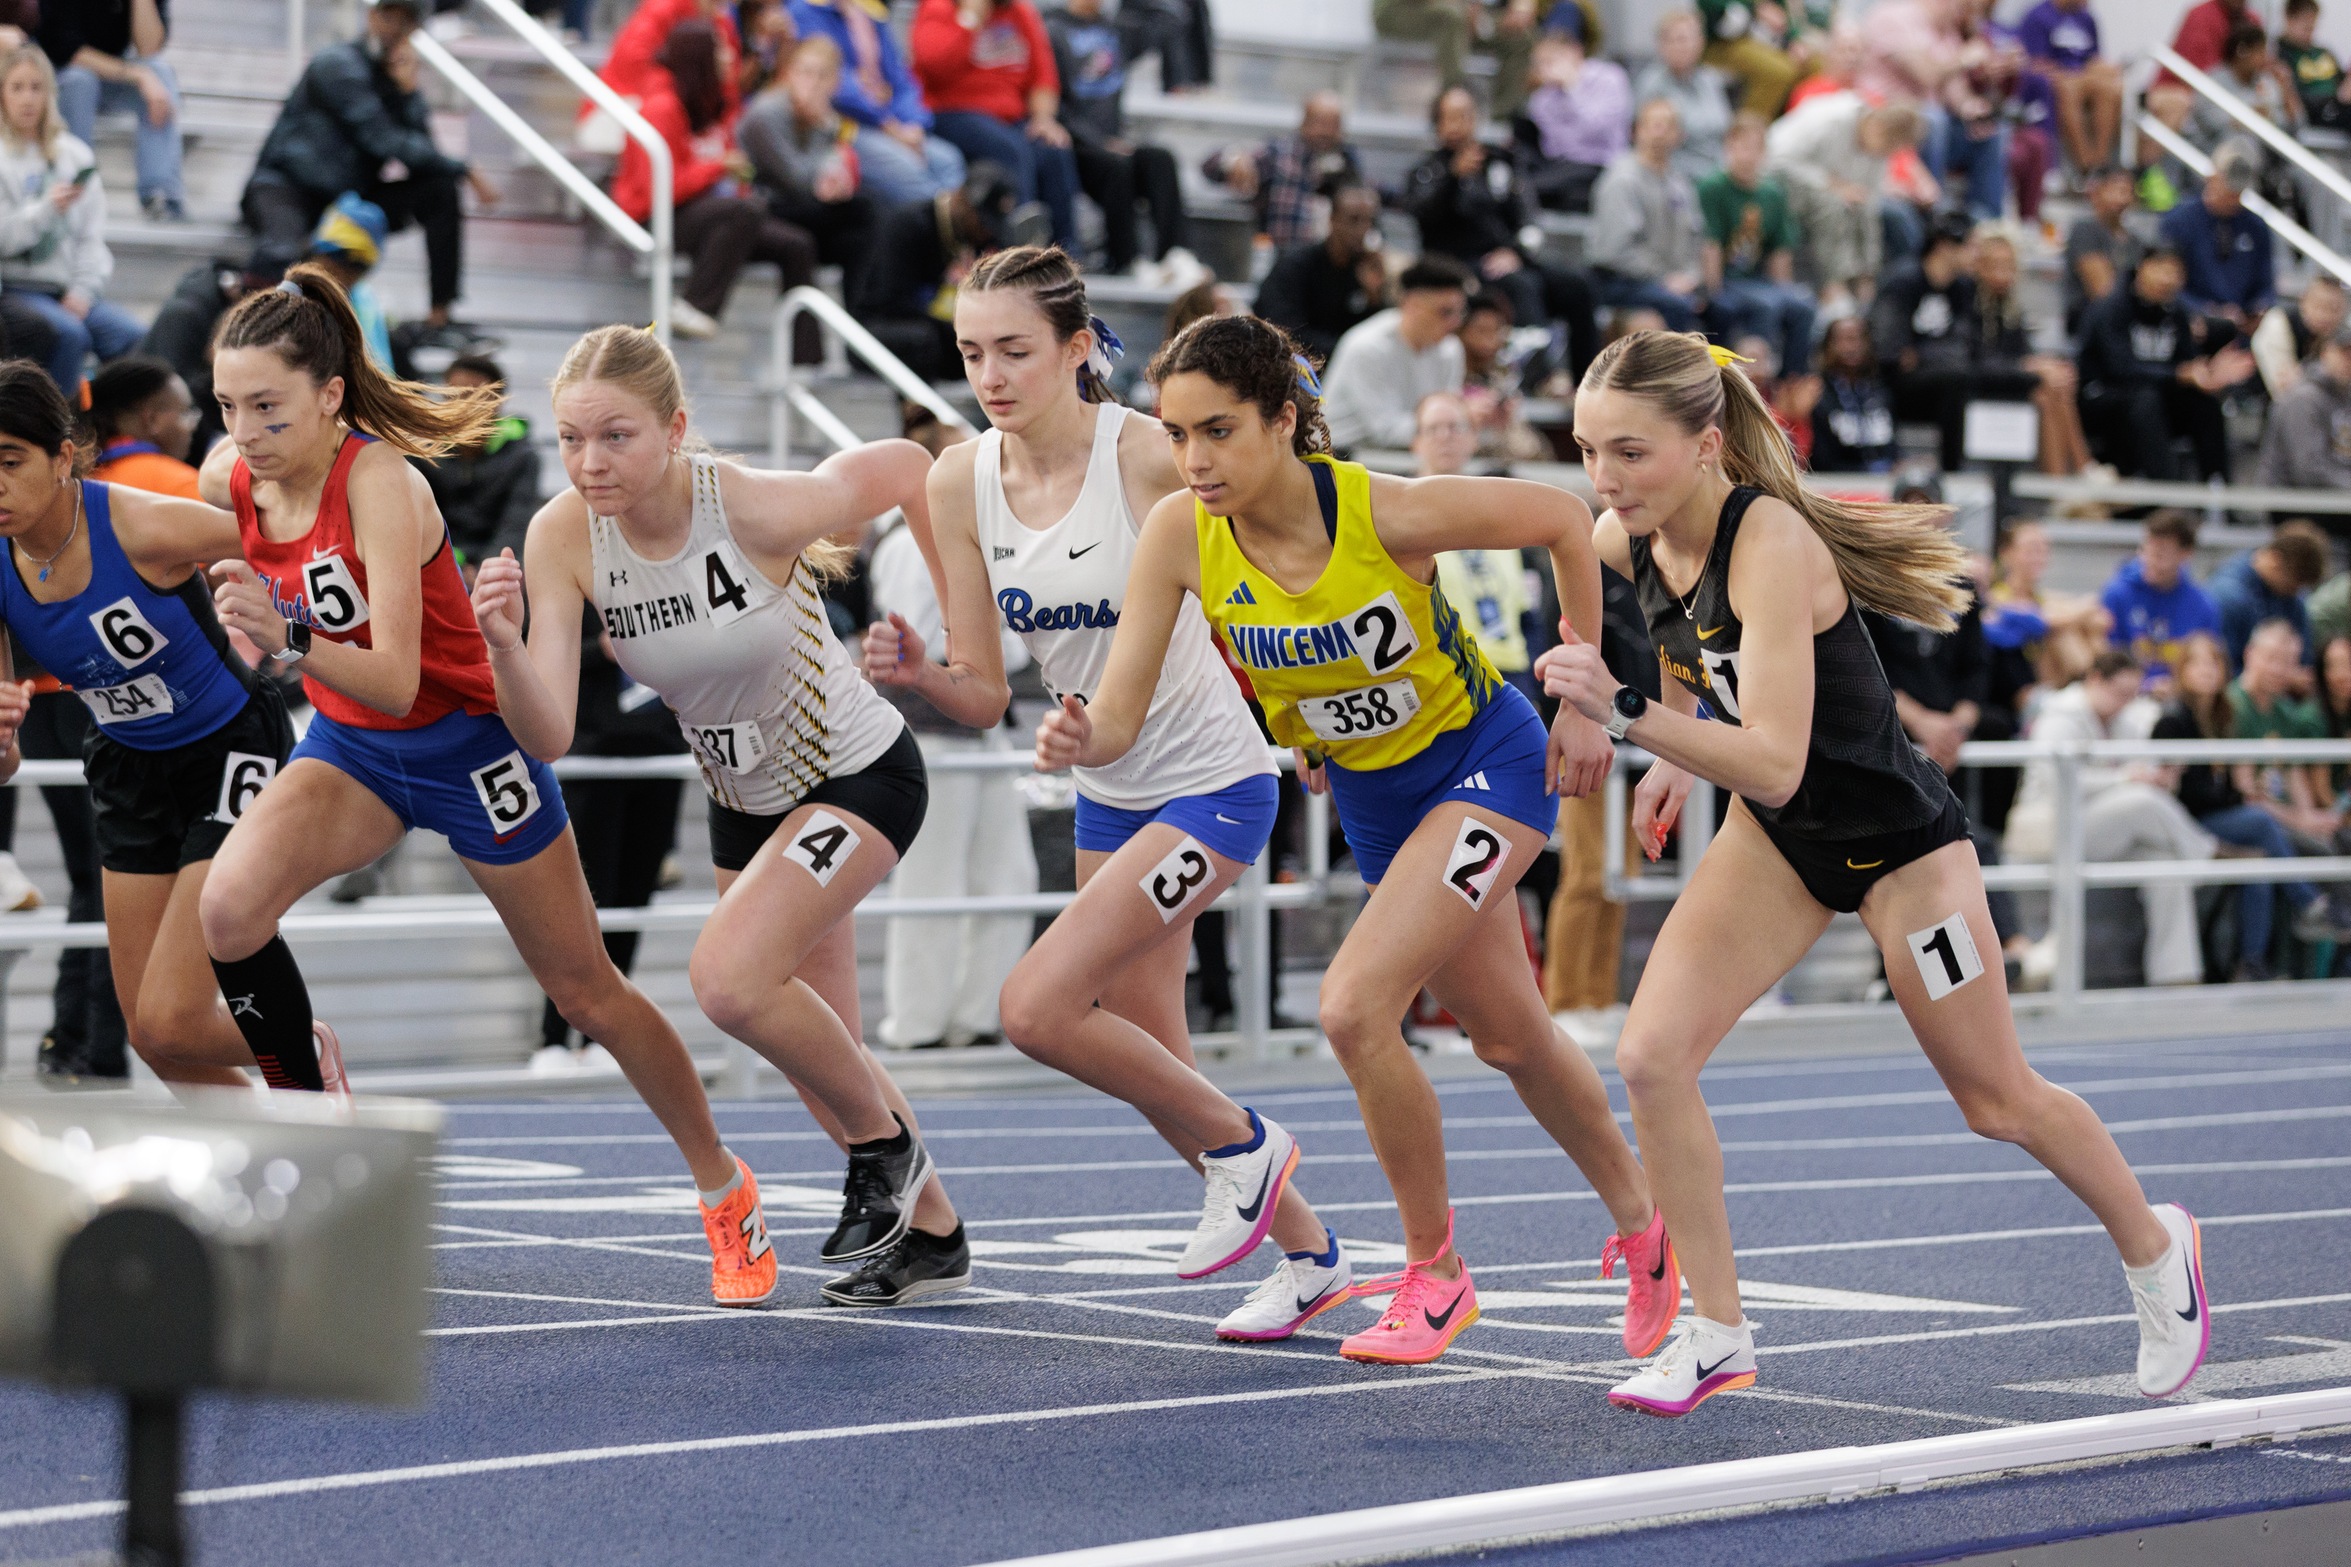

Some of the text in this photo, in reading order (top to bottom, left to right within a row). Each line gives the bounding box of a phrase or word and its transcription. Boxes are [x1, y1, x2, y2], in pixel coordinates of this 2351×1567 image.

[308, 563, 355, 628] 5
[706, 551, 748, 612] 4
[997, 588, 1121, 633] Bears
[102, 608, 154, 660] 6
[604, 593, 697, 640] SOUTHERN
[1353, 605, 1413, 671] 2
[94, 684, 157, 716] 254
[1323, 687, 1398, 735] 358
[228, 760, 268, 820] 6
[480, 760, 528, 822] 5
[798, 824, 849, 874] 4
[1450, 829, 1500, 903] 2
[1152, 850, 1207, 909] 3
[1921, 926, 1965, 986] 1
